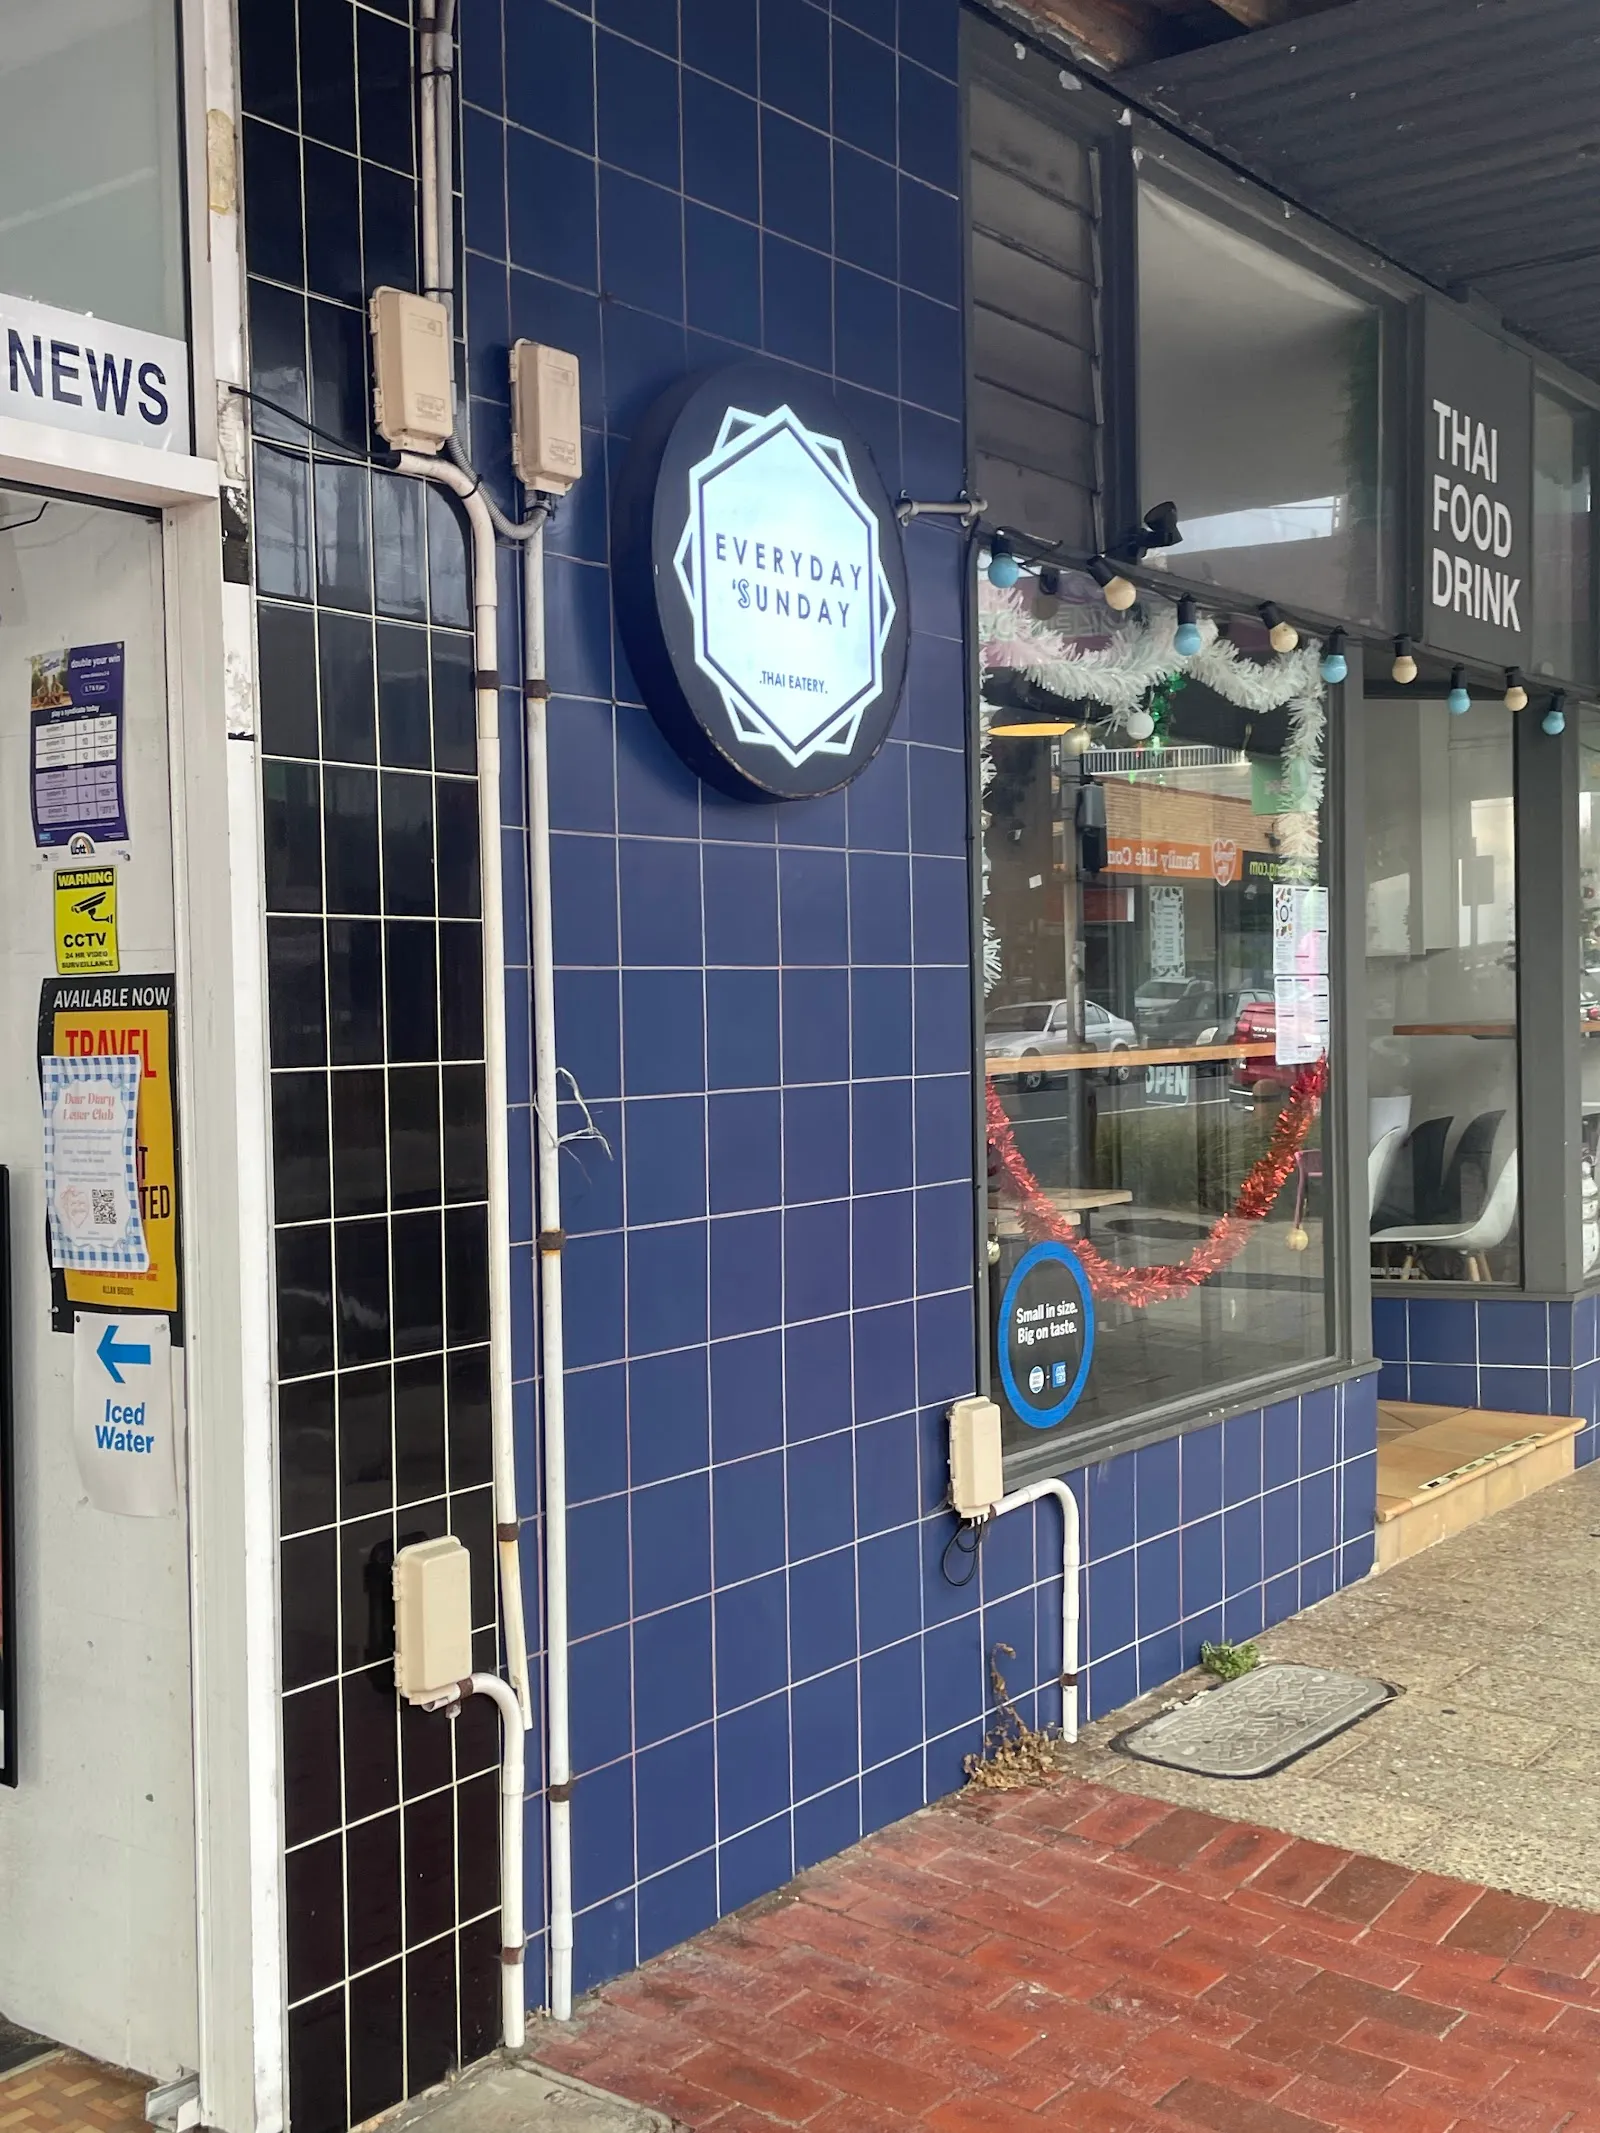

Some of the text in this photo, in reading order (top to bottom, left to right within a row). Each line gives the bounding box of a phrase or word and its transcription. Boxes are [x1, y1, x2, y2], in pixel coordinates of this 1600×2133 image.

[7, 328, 169, 426] NEWS
[1433, 398, 1498, 484] THAI
[1433, 473, 1512, 558] FOOD
[715, 532, 863, 591] EVERYDAY
[1432, 547, 1521, 632] DRINK
[71, 655, 120, 668] double your win
[58, 871, 113, 887] WARNING
[63, 932, 107, 948] CCTV
[61, 959, 114, 969] SURVEILLANCE
[86, 950, 108, 958] VIDEO
[53, 987, 171, 1008] AVAILABLE NOW
[1016, 1300, 1078, 1324] Small in size.
[1017, 1320, 1077, 1345] Big on taste.
[105, 1398, 145, 1425] Iced
[95, 1425, 154, 1453] Water
